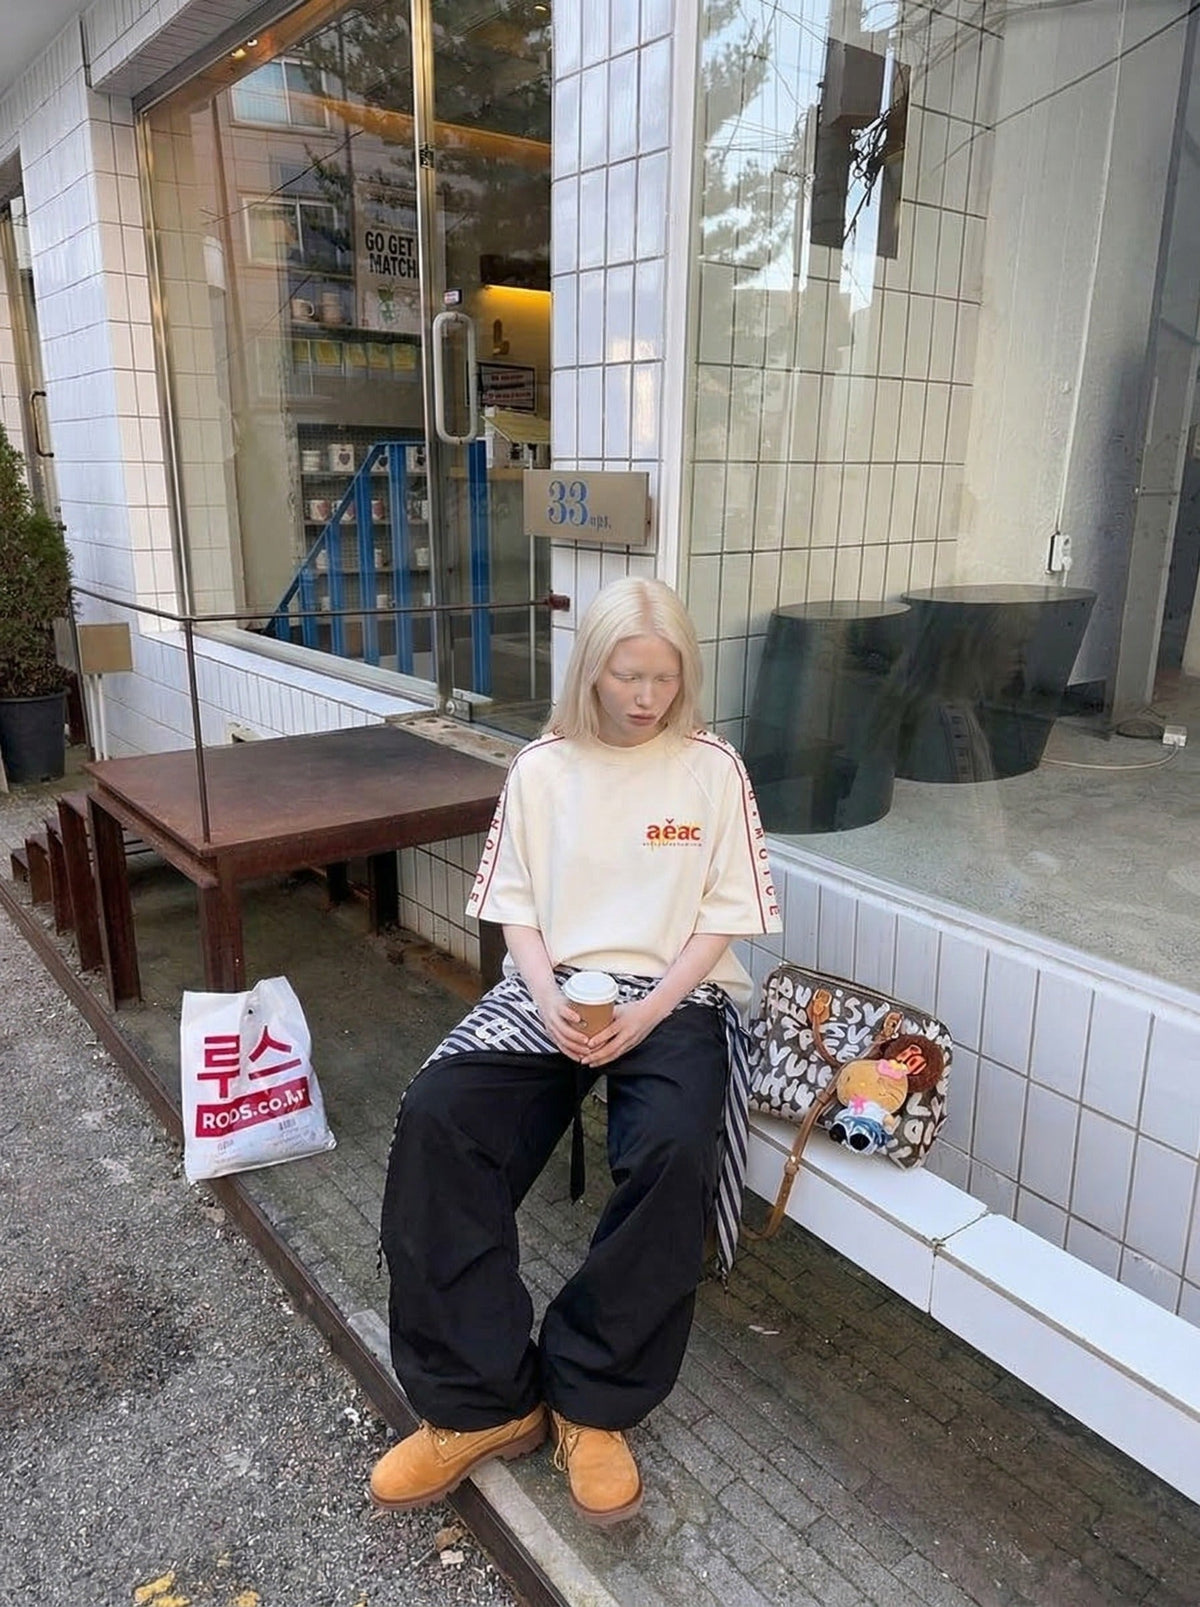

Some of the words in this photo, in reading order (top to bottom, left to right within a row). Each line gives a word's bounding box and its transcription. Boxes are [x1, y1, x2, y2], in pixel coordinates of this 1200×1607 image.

[365, 231, 385, 251] GO
[388, 234, 414, 258] GET
[369, 253, 420, 280] MATCH
[547, 480, 589, 527] 33
[197, 1025, 302, 1099] 루스
